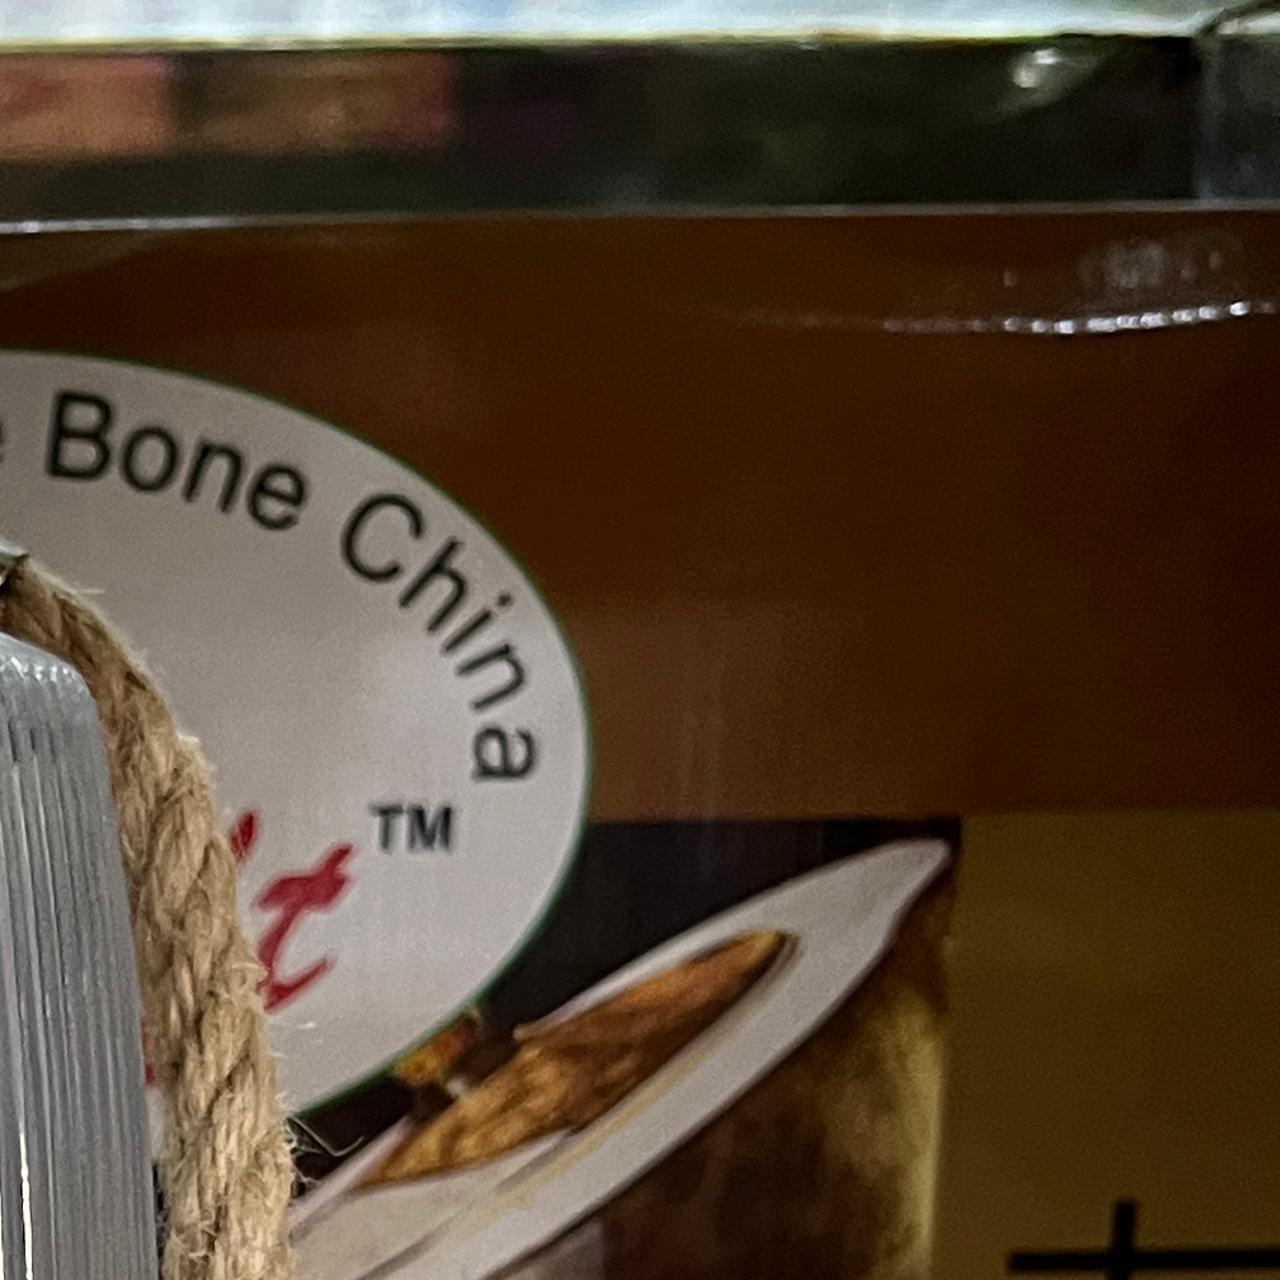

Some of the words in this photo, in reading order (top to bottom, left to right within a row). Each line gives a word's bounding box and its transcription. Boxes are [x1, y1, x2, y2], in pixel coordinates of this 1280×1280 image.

[44, 391, 307, 532] Bone
[340, 490, 538, 783] China
[369, 803, 455, 853] TM
